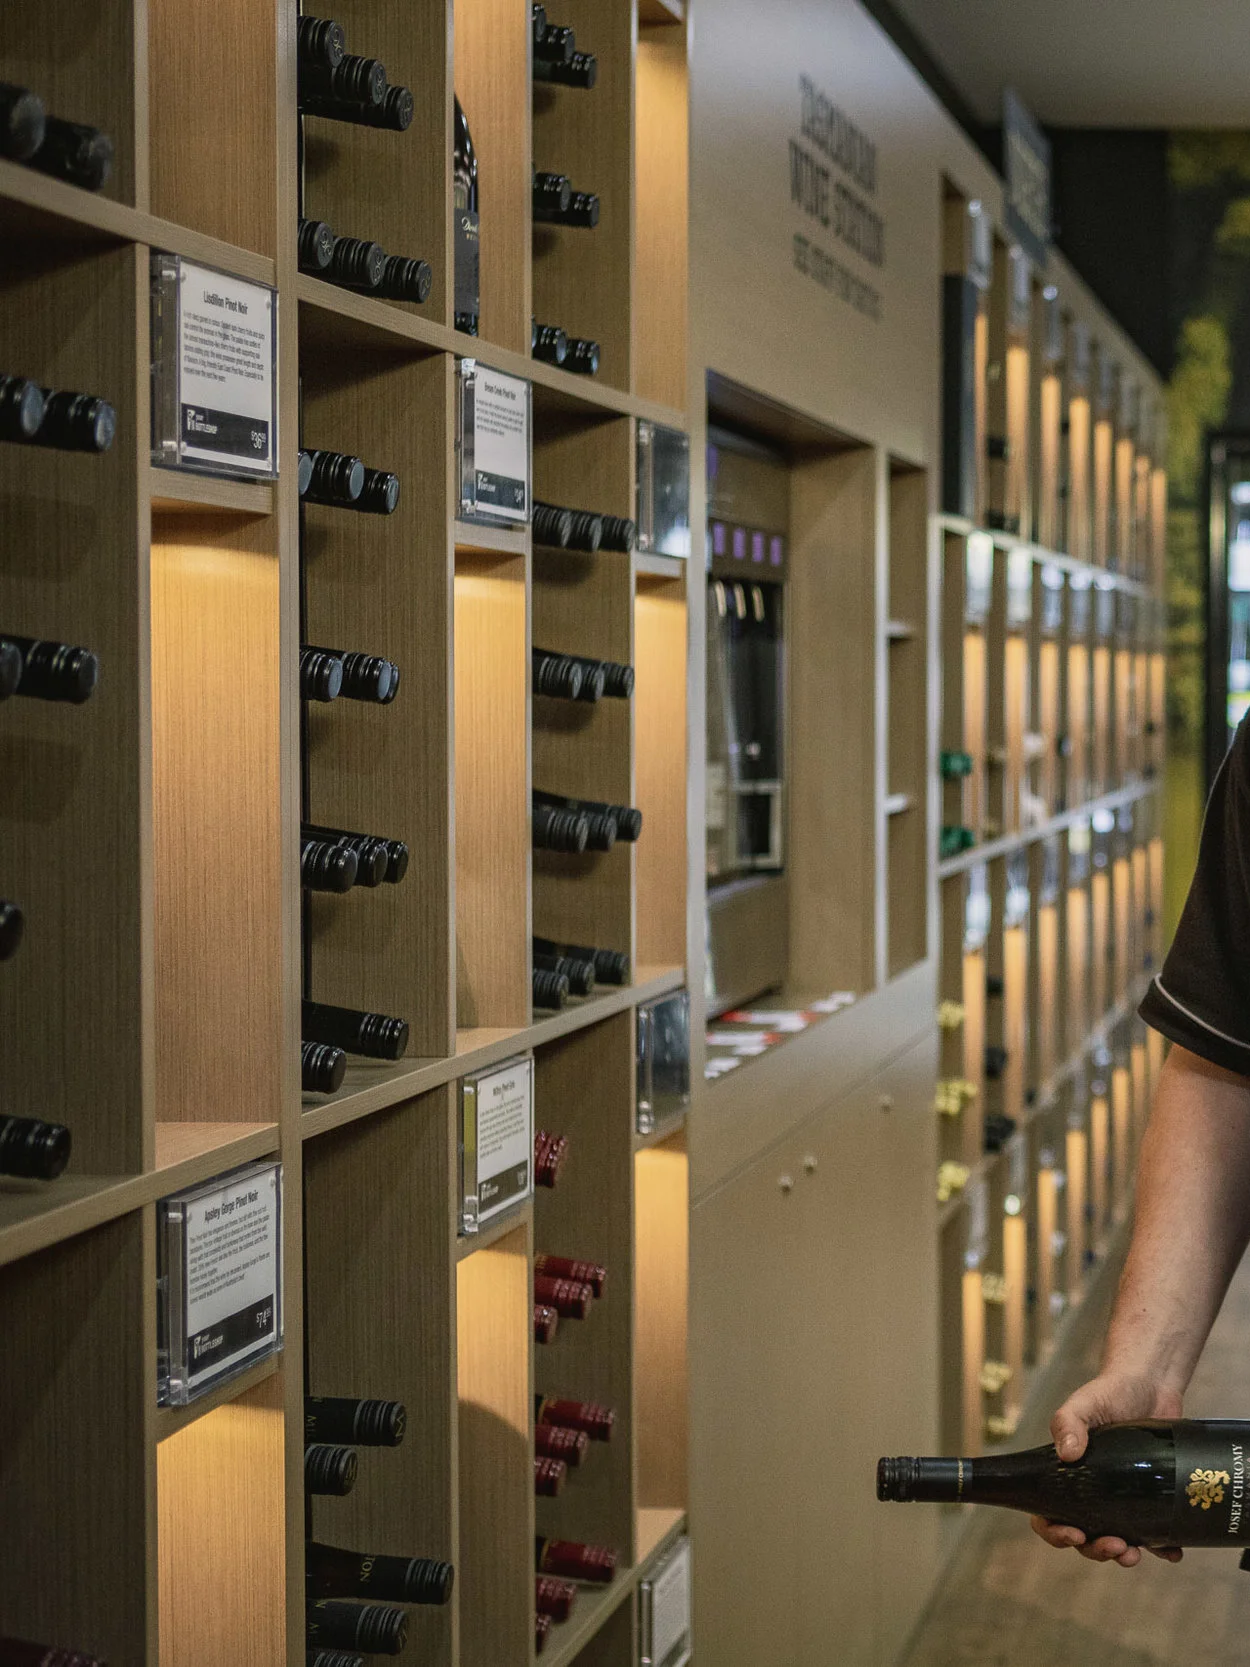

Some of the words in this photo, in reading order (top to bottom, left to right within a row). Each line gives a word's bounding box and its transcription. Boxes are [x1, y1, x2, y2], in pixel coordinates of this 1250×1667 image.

[225, 297, 237, 312] Pinot
[238, 301, 248, 315] Noir
[205, 1207, 220, 1223] Apsley
[235, 1194, 247, 1209] Pinot
[248, 1189, 259, 1203] Noir
[1232, 1444, 1244, 1499] CHROMY
[1228, 1500, 1243, 1533] JOSEF
